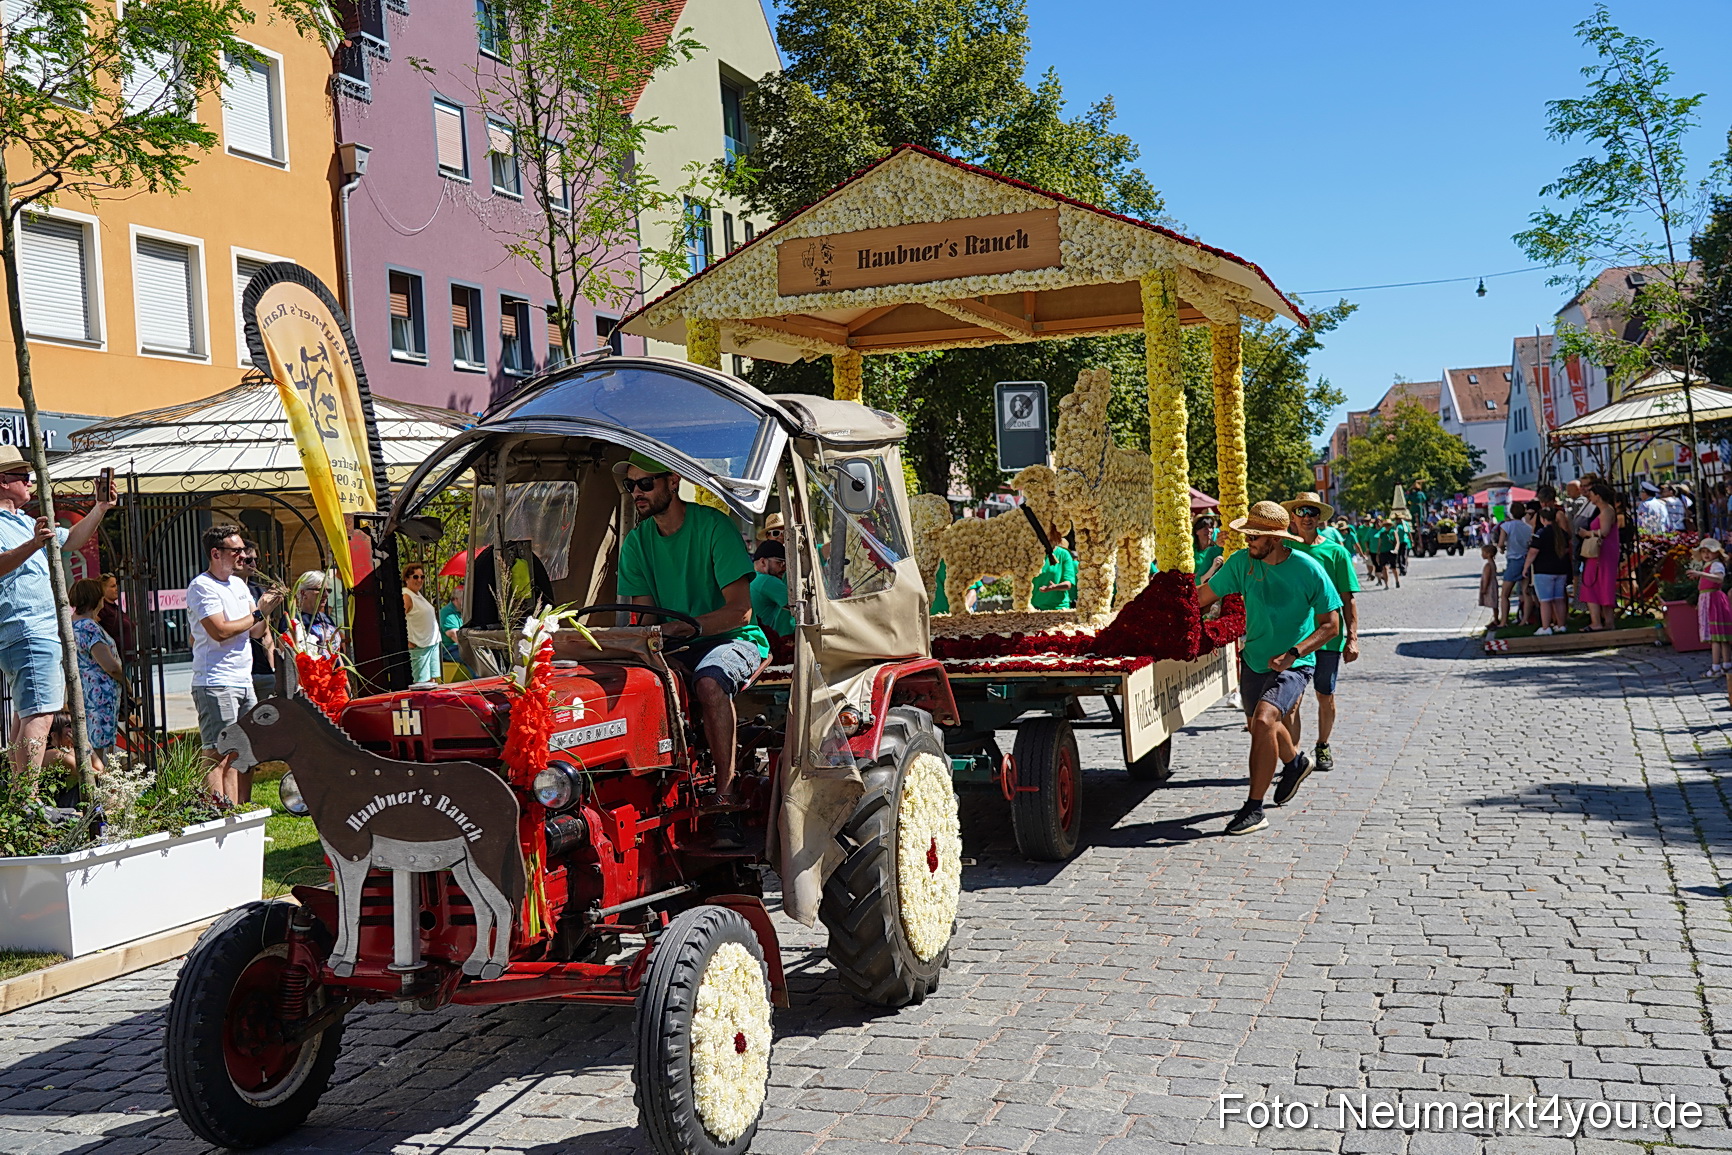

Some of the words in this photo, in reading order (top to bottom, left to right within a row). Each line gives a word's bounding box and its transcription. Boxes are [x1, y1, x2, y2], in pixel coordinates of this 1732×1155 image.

[964, 228, 1030, 256] Ranch
[1571, 379, 1587, 416] SALE
[1013, 420, 1032, 428] ZONE
[434, 794, 484, 843] Ranch
